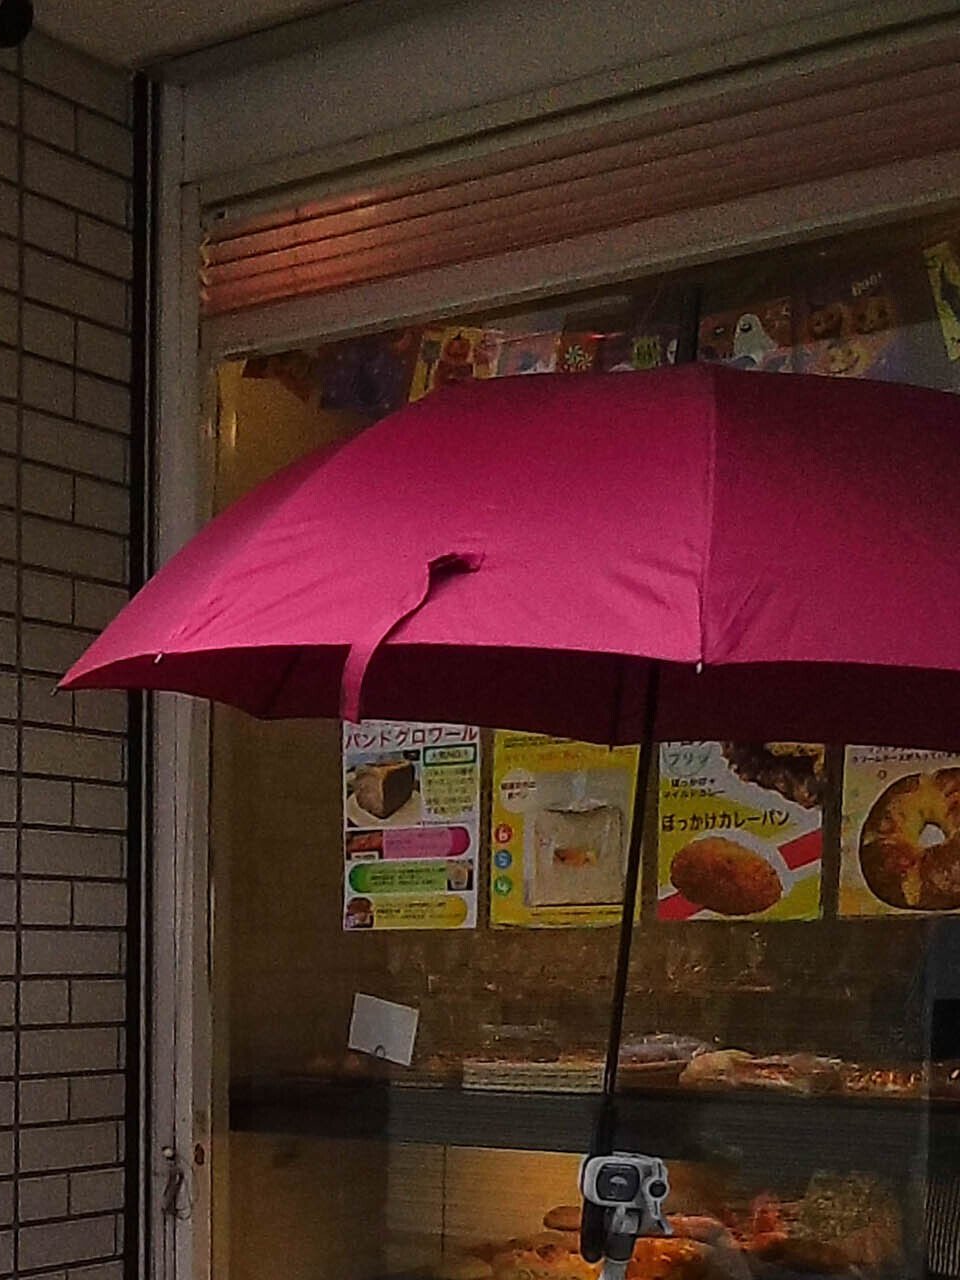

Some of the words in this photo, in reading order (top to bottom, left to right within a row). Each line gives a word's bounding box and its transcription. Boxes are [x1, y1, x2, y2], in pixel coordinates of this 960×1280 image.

[661, 808, 790, 832] ぼっかけカレーパン
